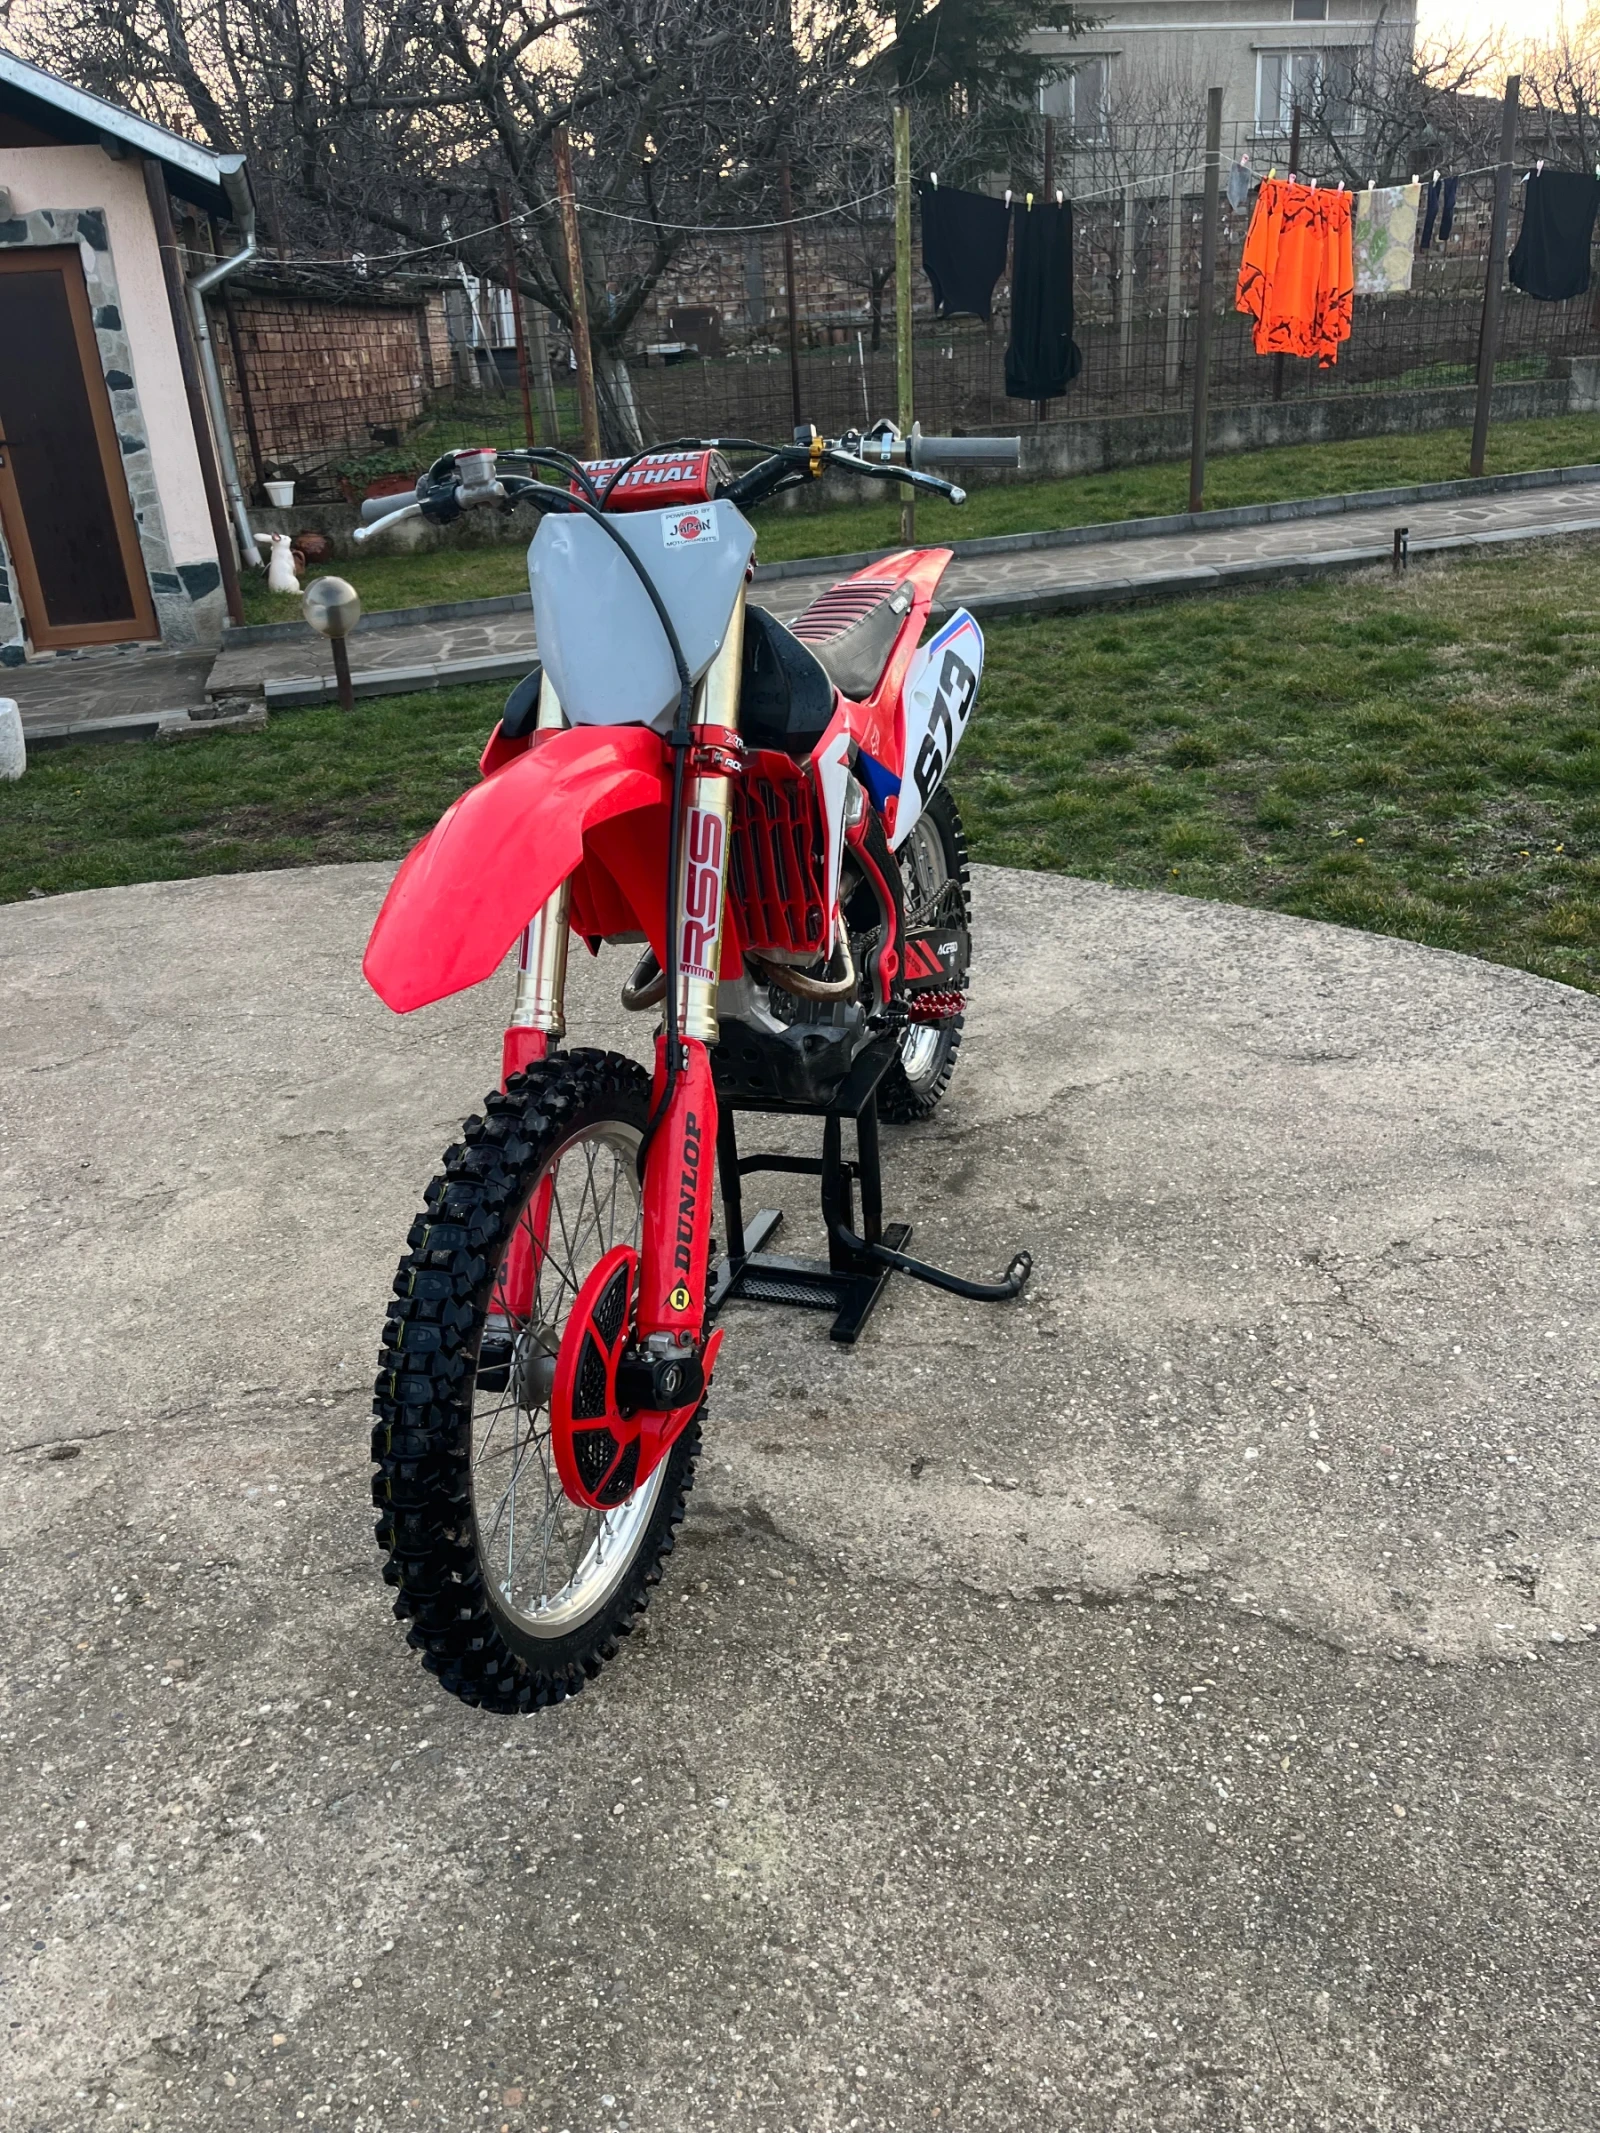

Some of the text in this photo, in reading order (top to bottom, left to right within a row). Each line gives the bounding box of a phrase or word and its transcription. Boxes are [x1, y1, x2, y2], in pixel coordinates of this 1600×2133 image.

[665, 509, 699, 520] POWERED
[913, 649, 976, 811] 673
[682, 810, 722, 967] RSS
[674, 1111, 702, 1275] DUNLOP
